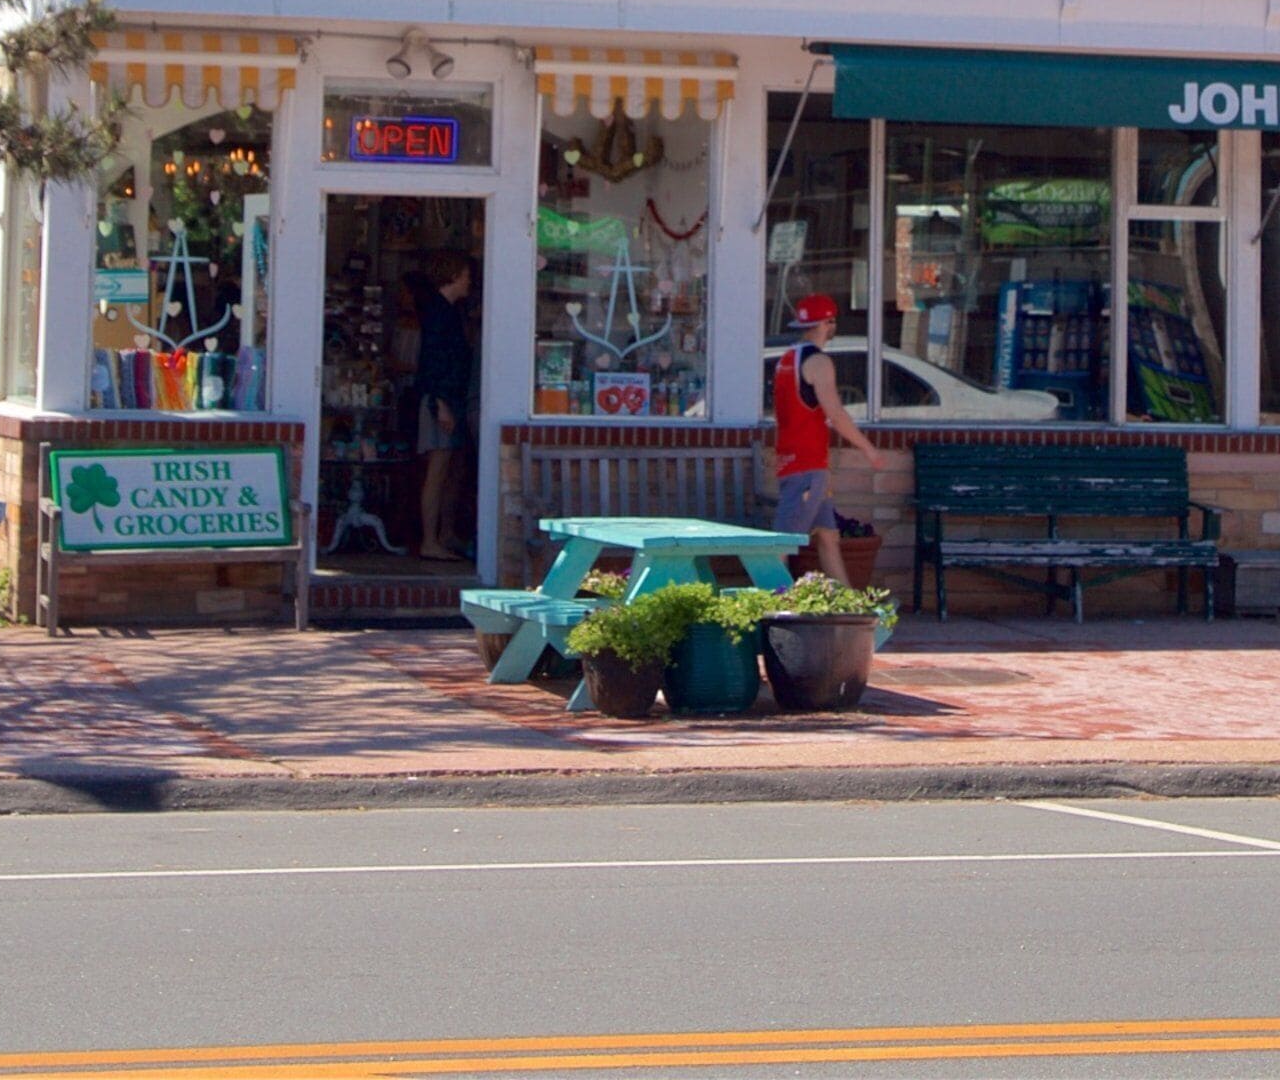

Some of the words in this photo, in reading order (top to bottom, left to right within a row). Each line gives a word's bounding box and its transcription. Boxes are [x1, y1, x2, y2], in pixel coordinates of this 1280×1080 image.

[359, 123, 451, 156] OPEN
[152, 460, 233, 482] IRISH
[130, 486, 227, 509] CANDY
[238, 485, 260, 507] &
[114, 511, 280, 537] GROCERIES
